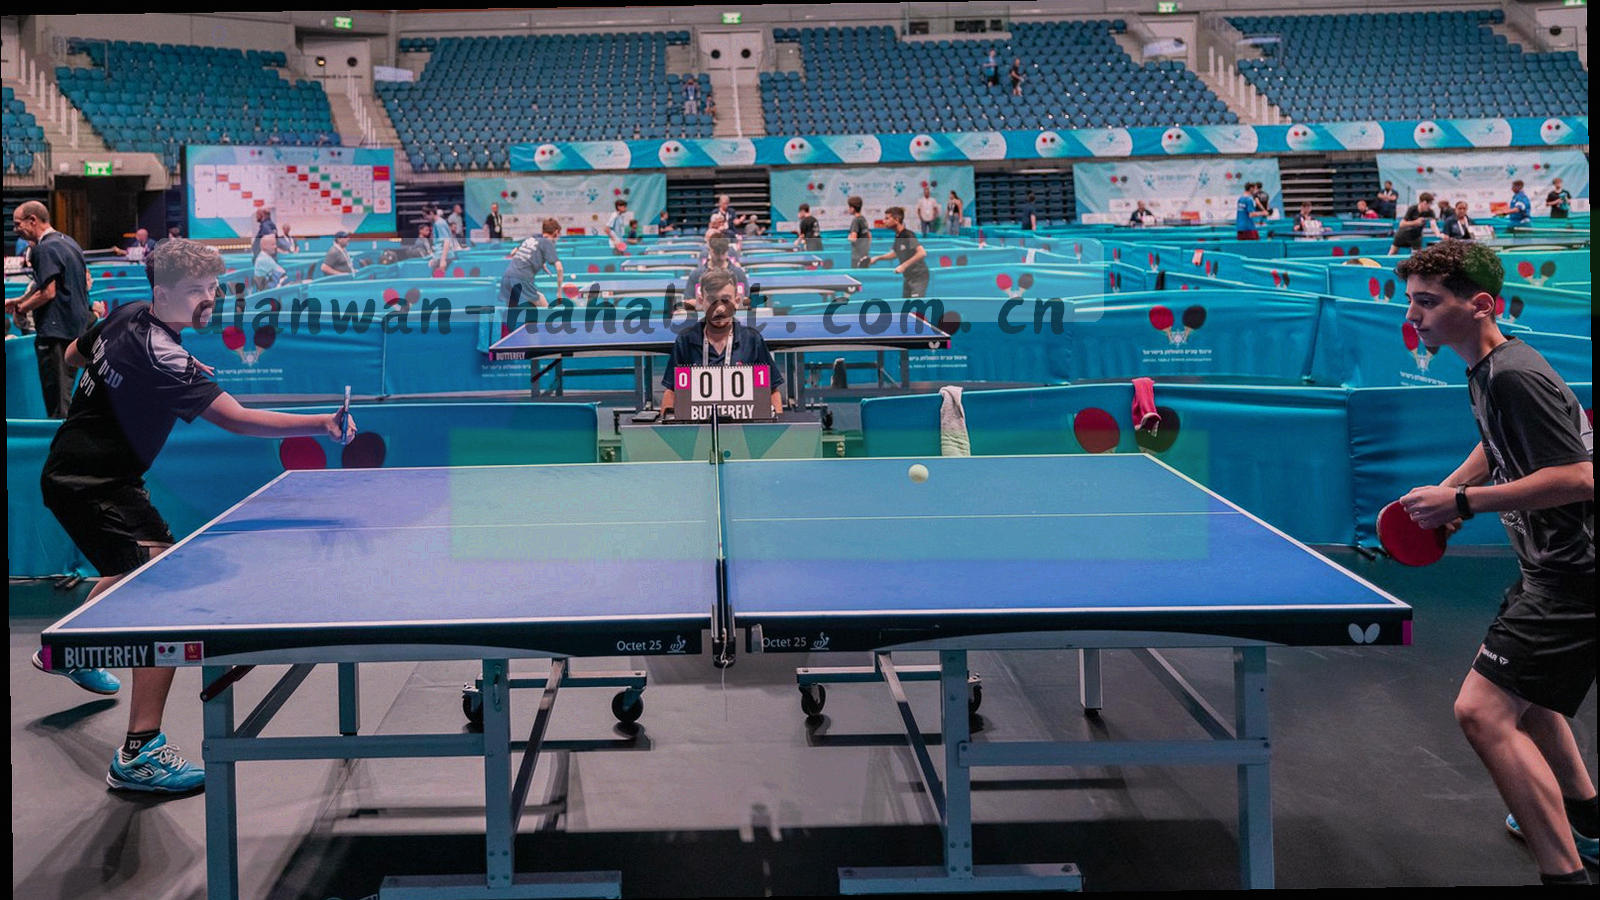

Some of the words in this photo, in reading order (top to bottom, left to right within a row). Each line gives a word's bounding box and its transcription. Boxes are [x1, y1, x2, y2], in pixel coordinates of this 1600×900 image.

[678, 372, 688, 387] 0
[700, 371, 712, 398] 0
[732, 371, 744, 398] 0
[758, 370, 764, 385] 1
[616, 640, 647, 651] Octet
[649, 639, 662, 650] 25
[762, 637, 792, 648] Octet
[794, 636, 807, 647] 25
[64, 645, 149, 668] BUTTERFLY
